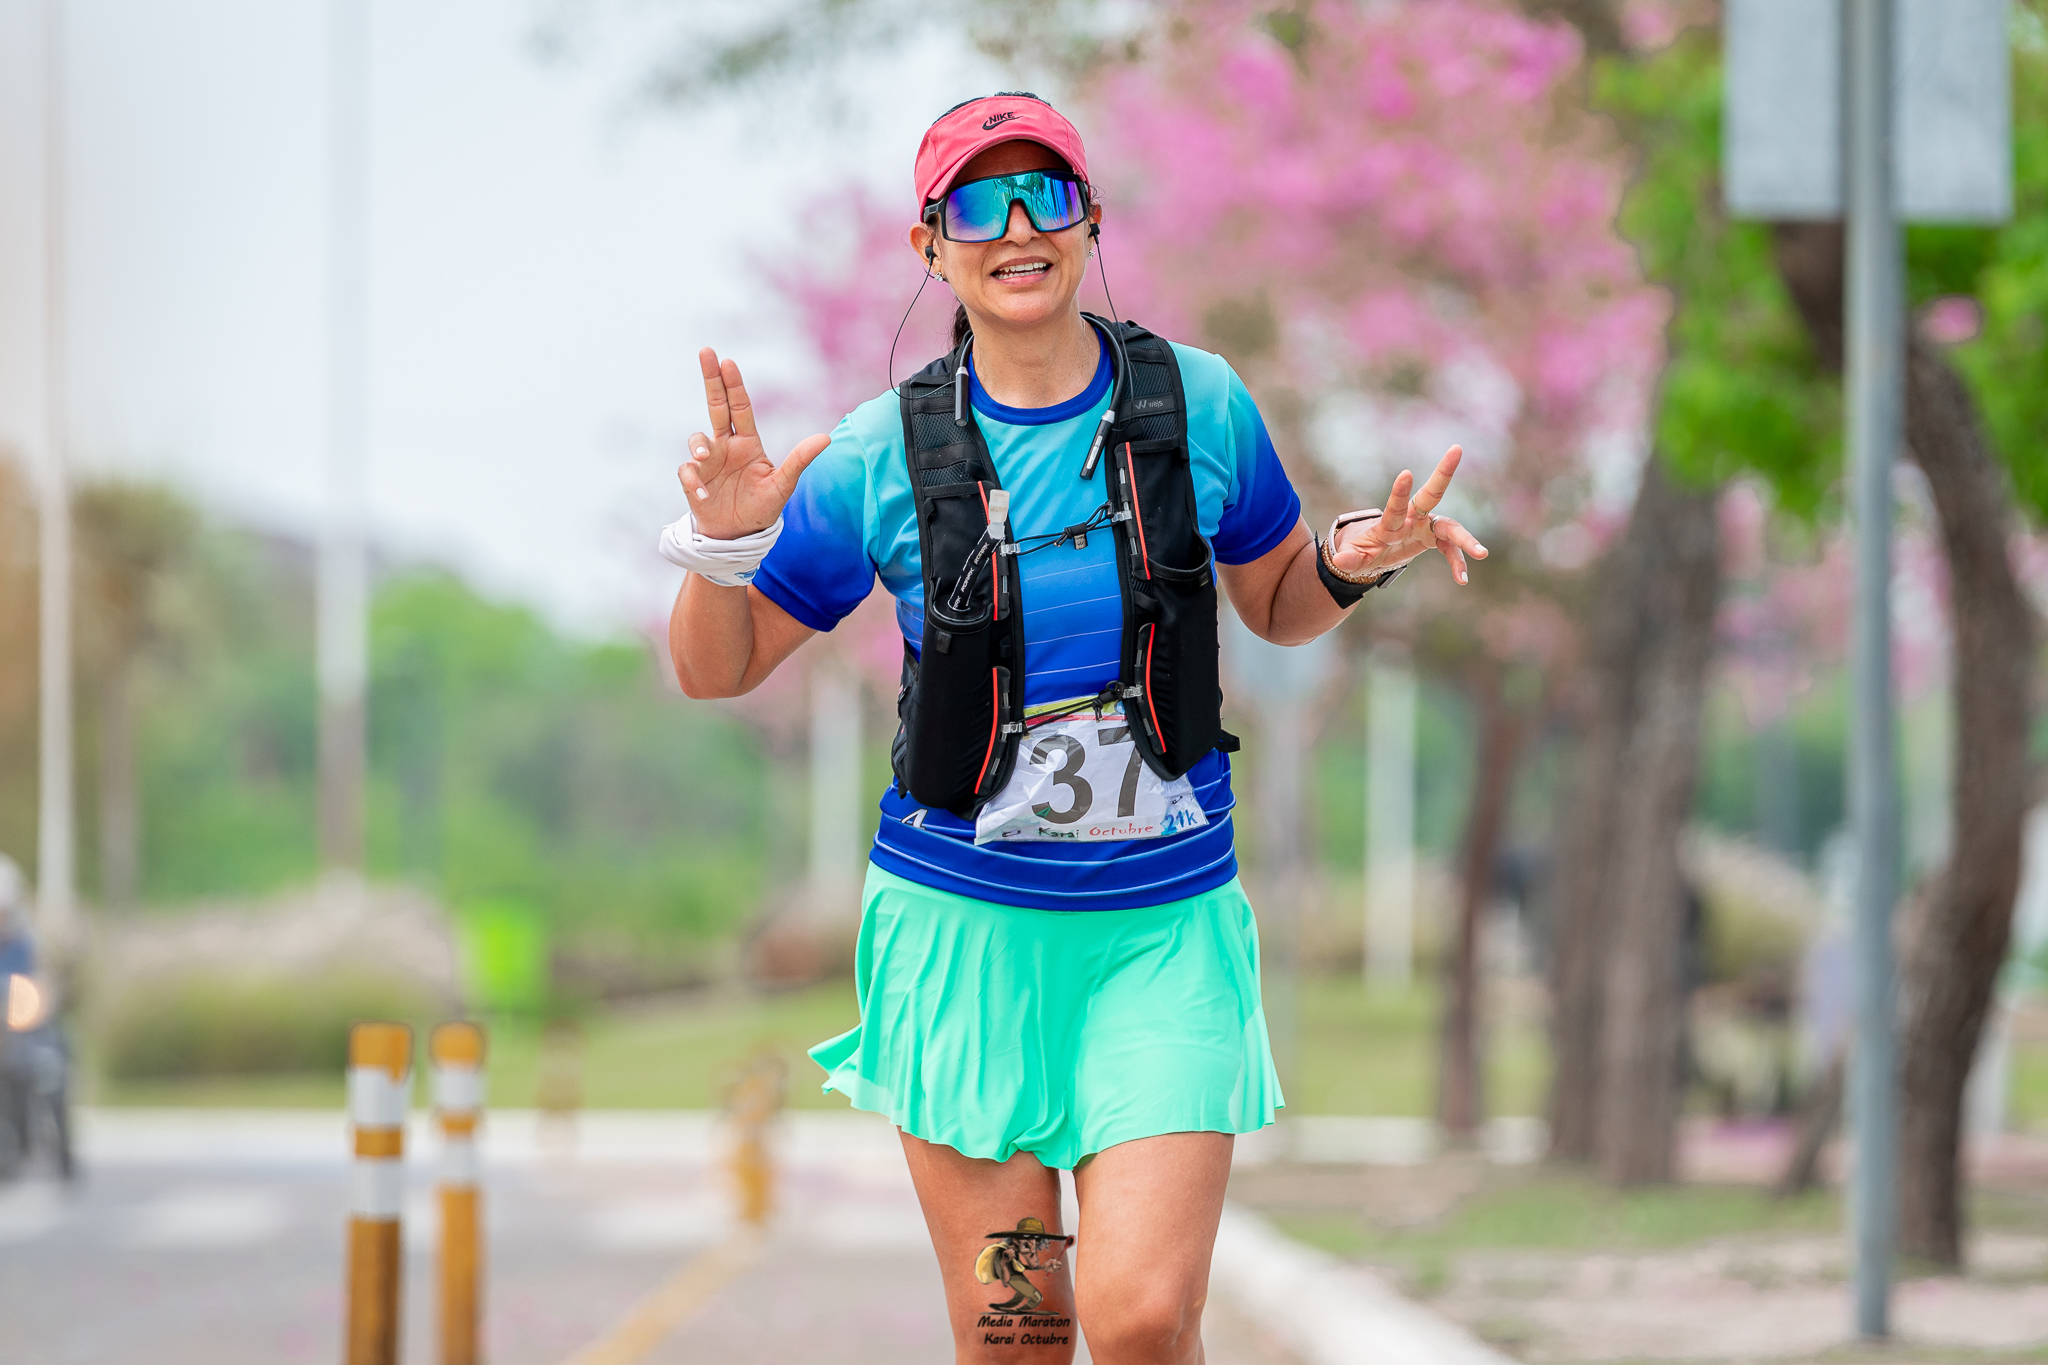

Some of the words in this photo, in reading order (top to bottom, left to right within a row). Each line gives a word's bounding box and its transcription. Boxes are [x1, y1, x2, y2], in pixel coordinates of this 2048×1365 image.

[988, 111, 1014, 124] NIKE
[1029, 727, 1145, 825] 37
[1038, 827, 1080, 838] Karai
[1089, 822, 1153, 836] Octubre
